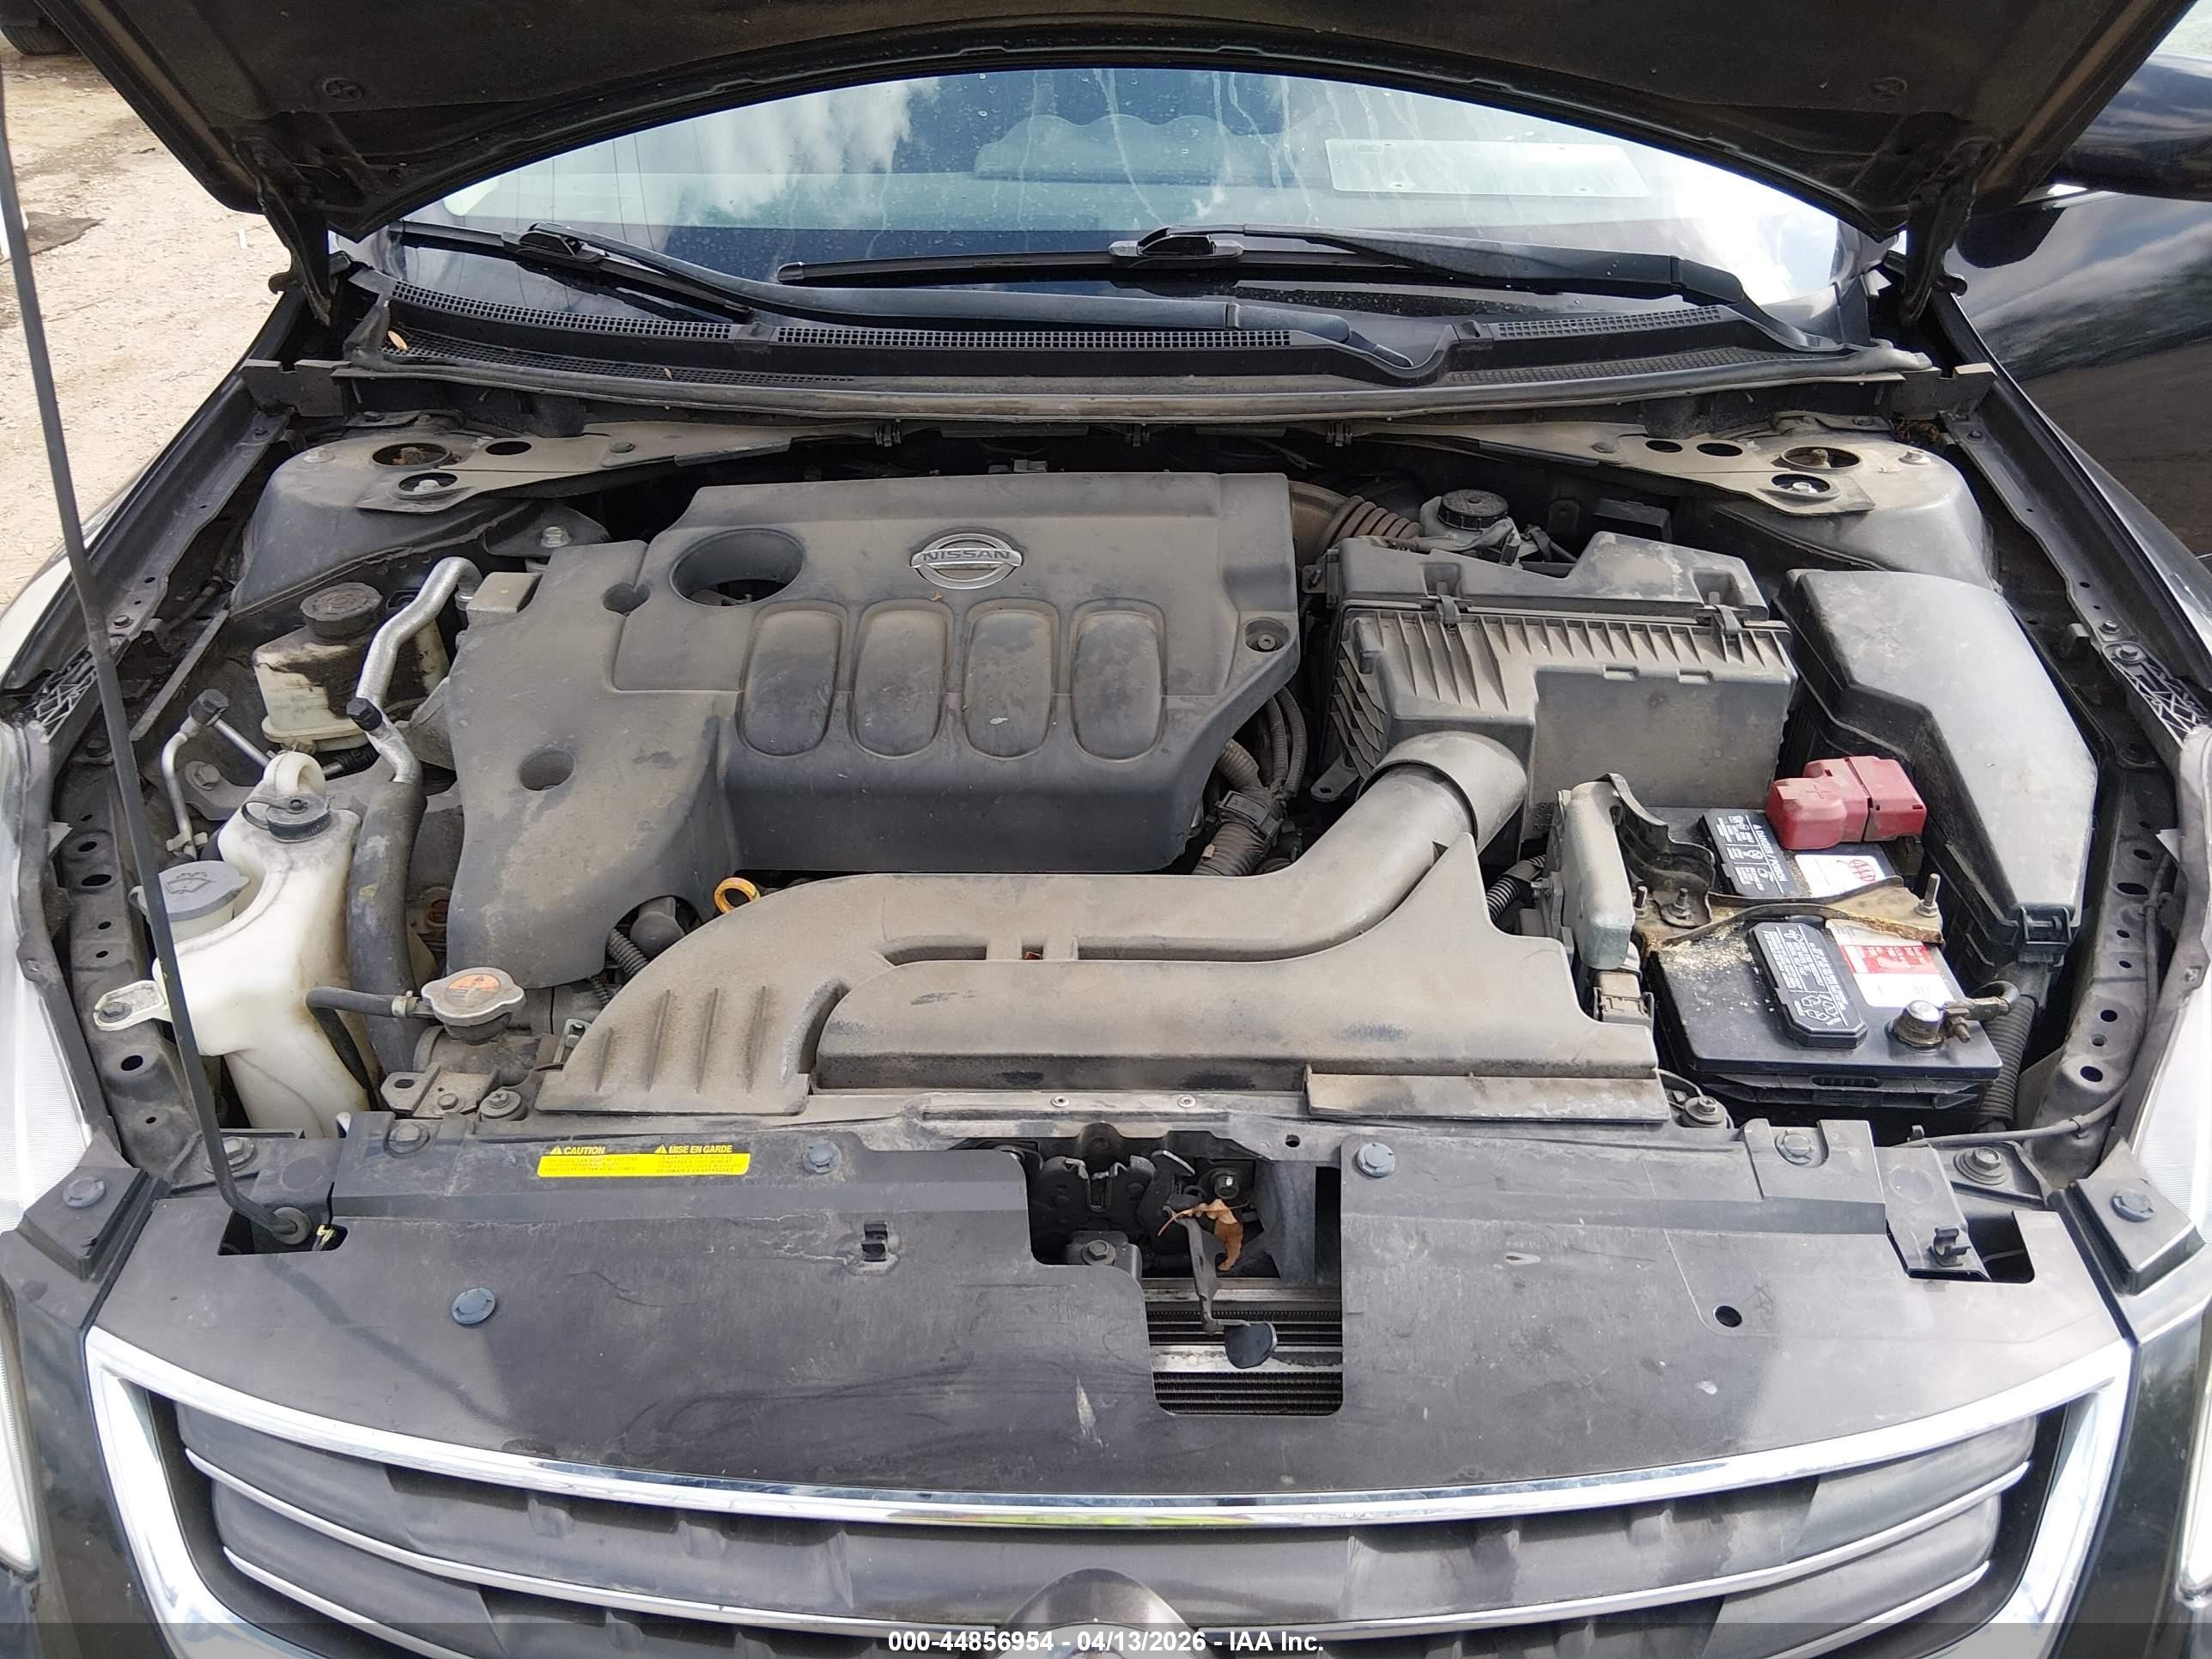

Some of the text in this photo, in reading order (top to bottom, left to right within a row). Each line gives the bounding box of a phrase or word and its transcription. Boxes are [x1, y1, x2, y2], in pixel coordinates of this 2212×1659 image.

[922, 550, 1011, 561] NISSAN
[562, 1146, 605, 1155] CAUTION
[668, 1145, 733, 1154] MISE EN GARDE
